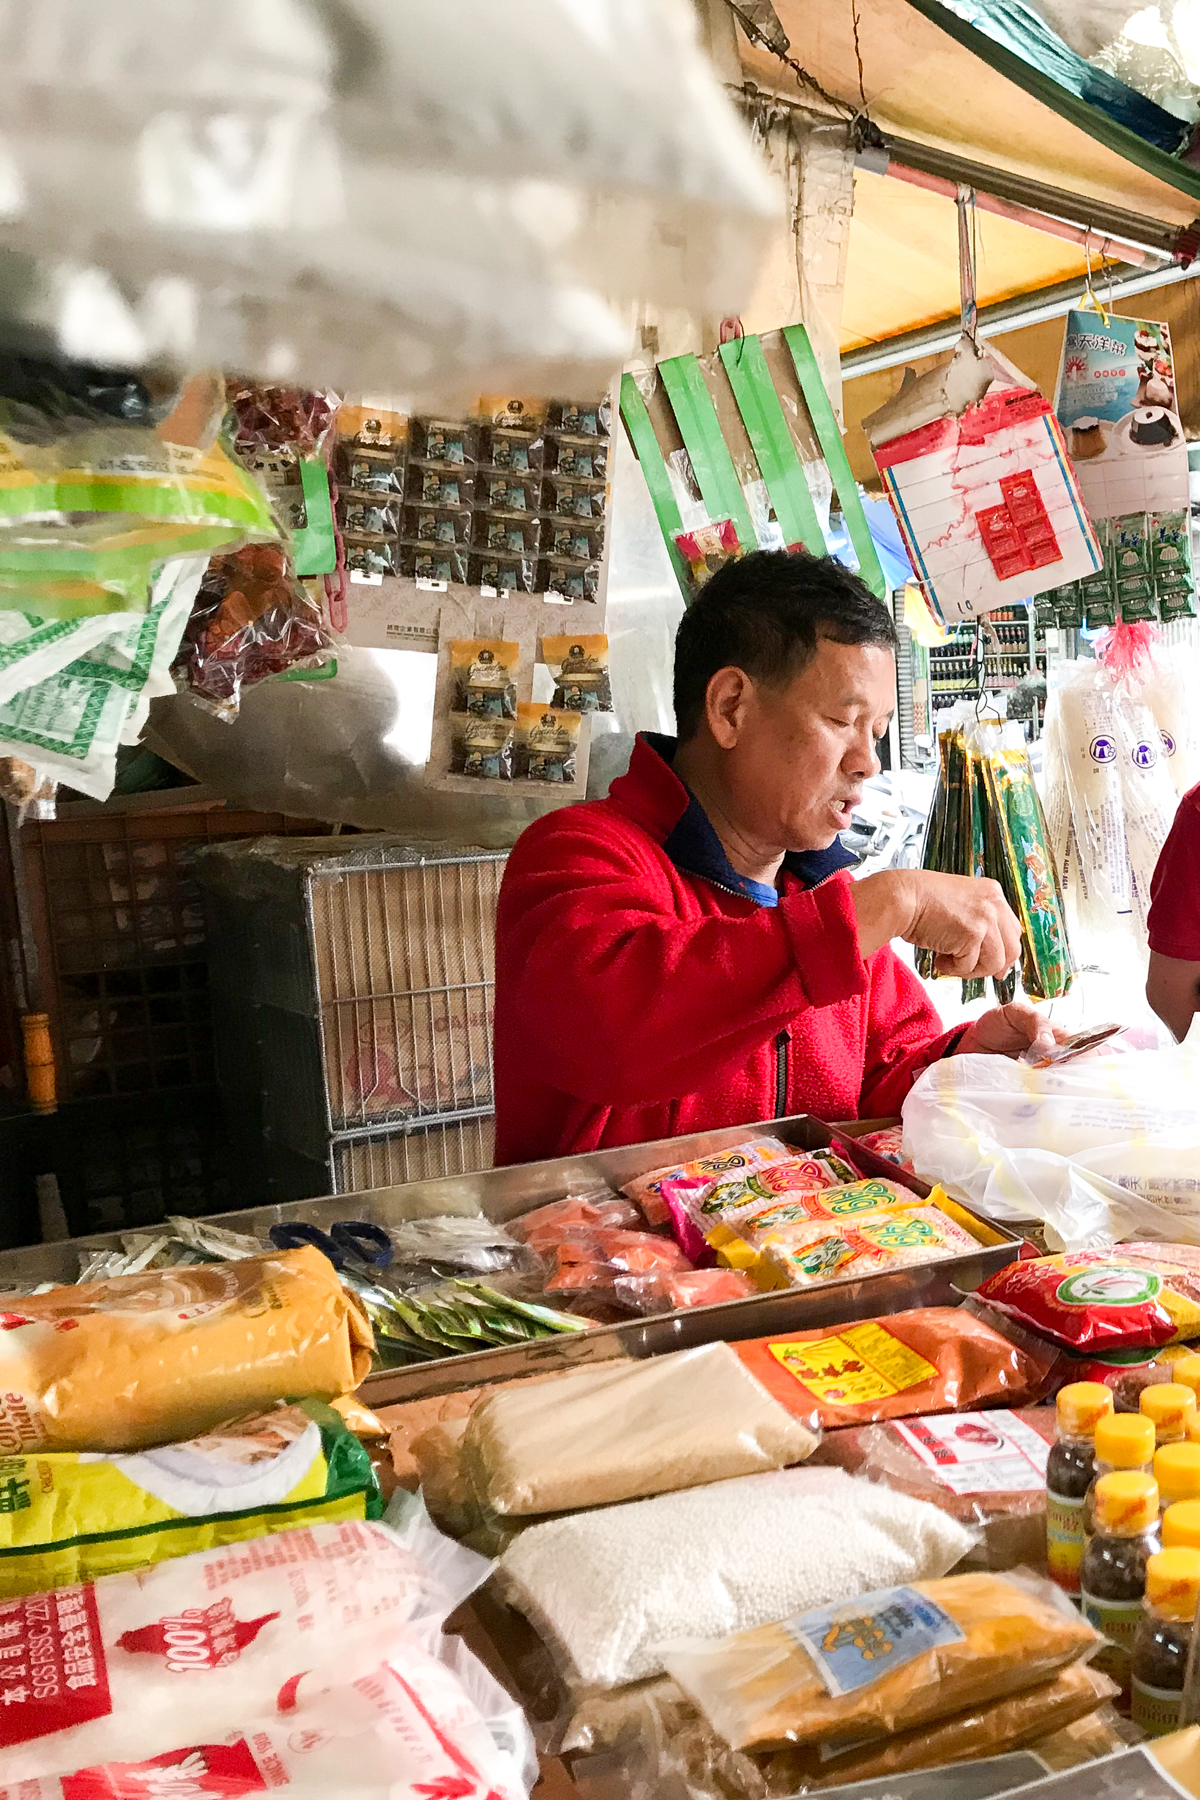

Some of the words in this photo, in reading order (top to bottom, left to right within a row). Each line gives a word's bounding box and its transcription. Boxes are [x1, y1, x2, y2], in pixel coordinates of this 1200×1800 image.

[28, 1622, 56, 1666] FSSC
[159, 1608, 212, 1673] 100%
[32, 1666, 59, 1699] SGS
